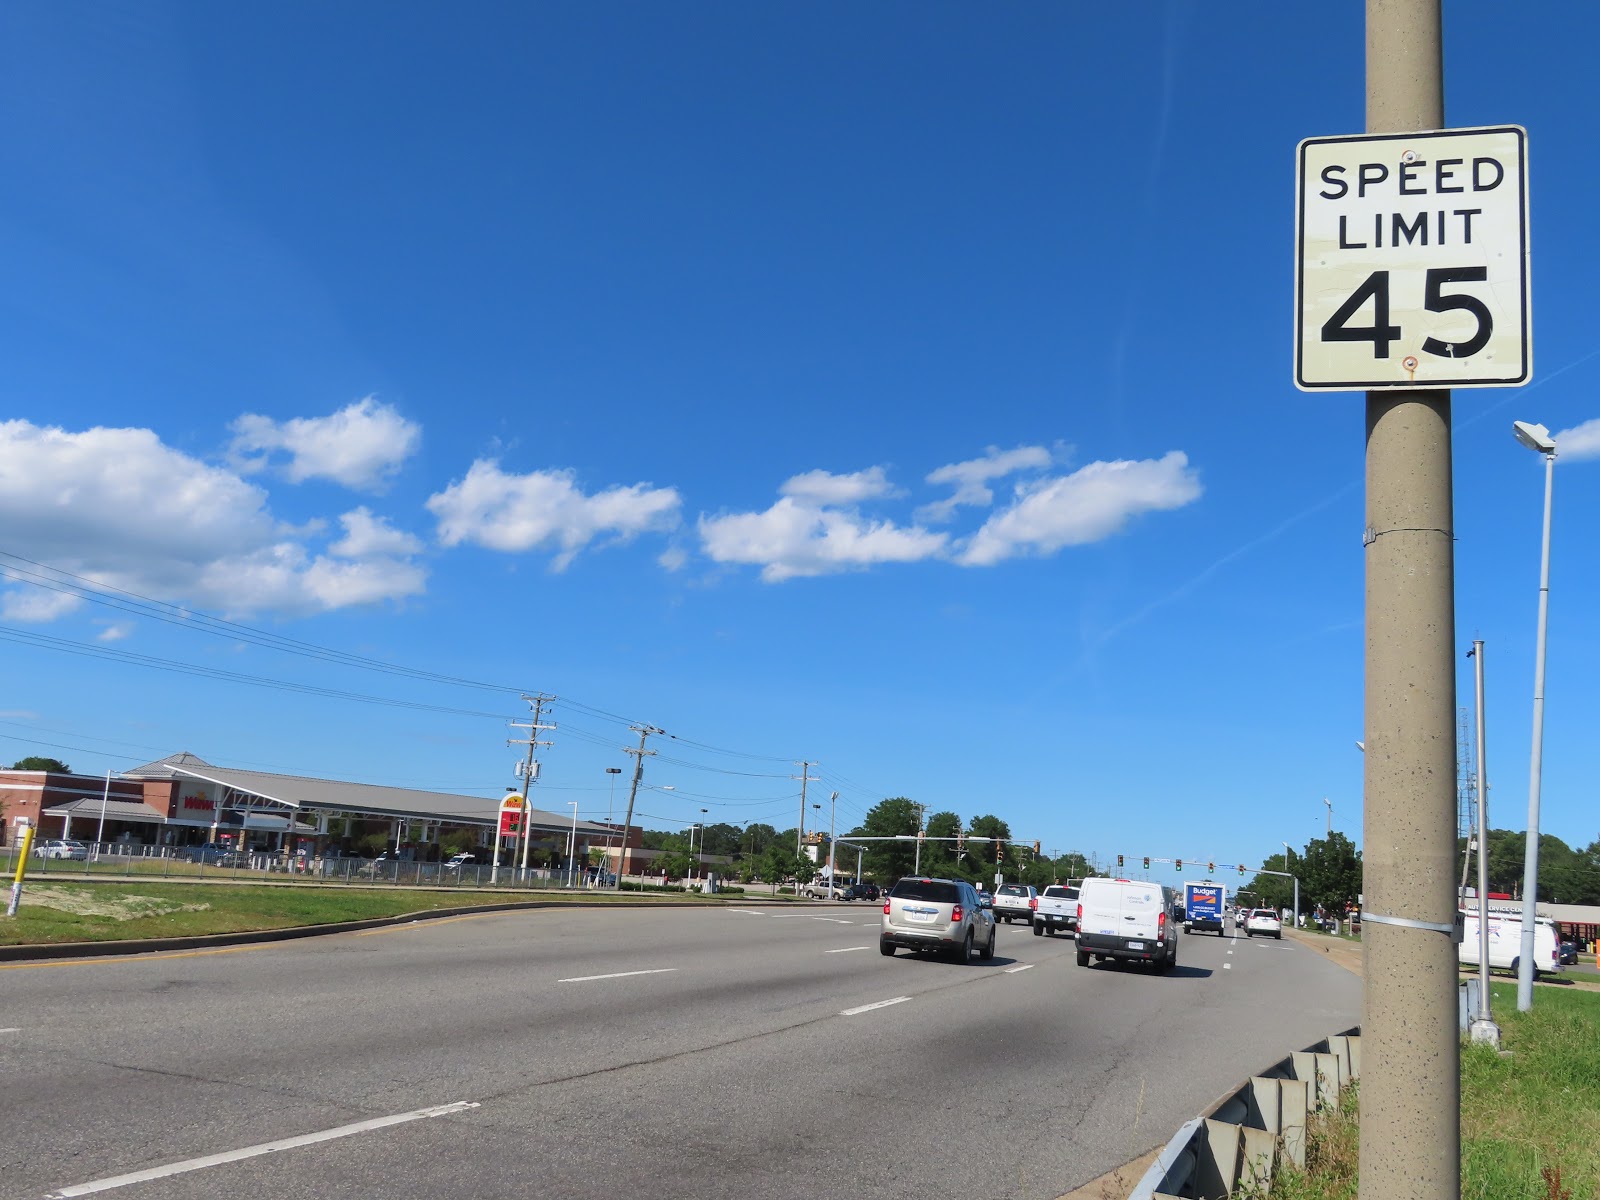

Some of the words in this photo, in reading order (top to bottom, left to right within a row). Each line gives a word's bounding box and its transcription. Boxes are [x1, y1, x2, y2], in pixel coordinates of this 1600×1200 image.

[1319, 157, 1504, 200] SPEED
[1339, 208, 1482, 249] LIMIT
[1321, 266, 1494, 359] 45
[1193, 887, 1216, 896] Budget
